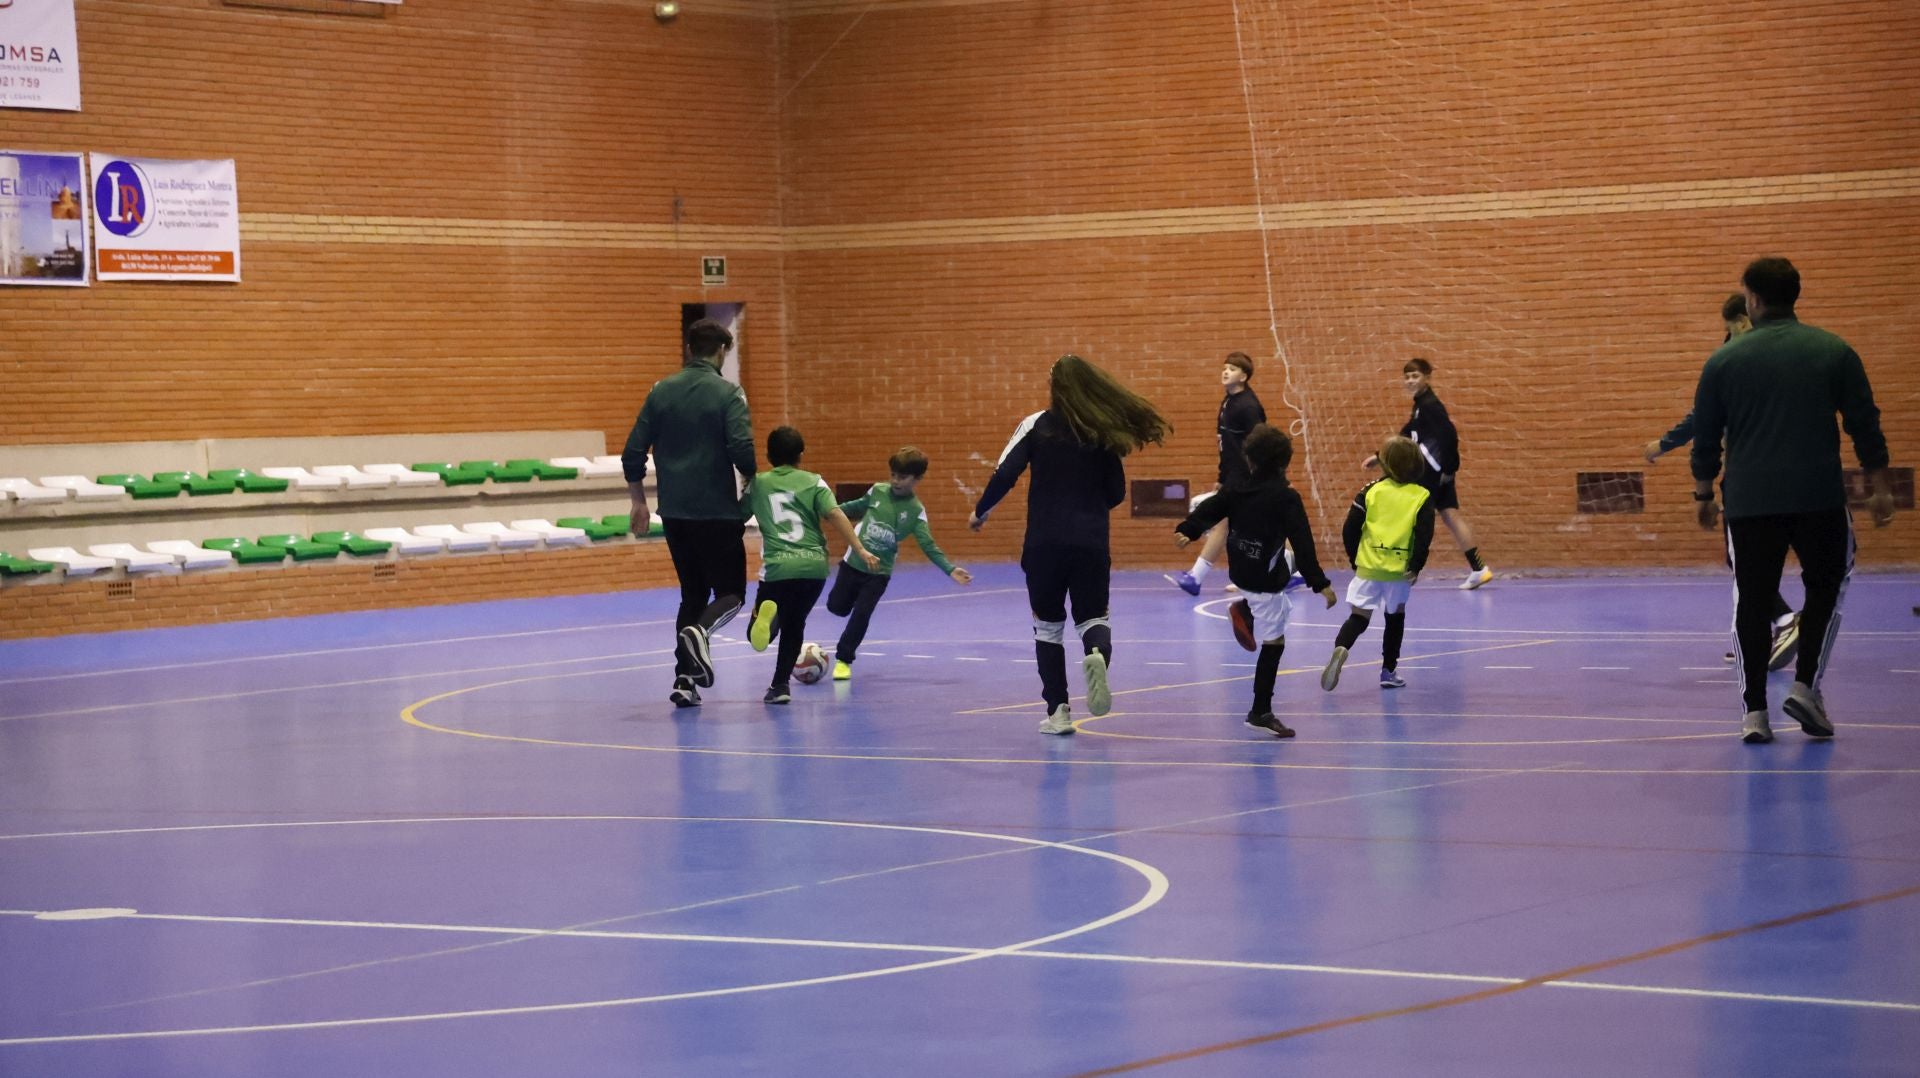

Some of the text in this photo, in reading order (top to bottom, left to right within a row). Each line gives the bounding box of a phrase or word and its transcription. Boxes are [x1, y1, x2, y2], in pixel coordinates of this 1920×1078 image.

[0, 76, 40, 88] 21 759
[768, 490, 804, 543] 5
